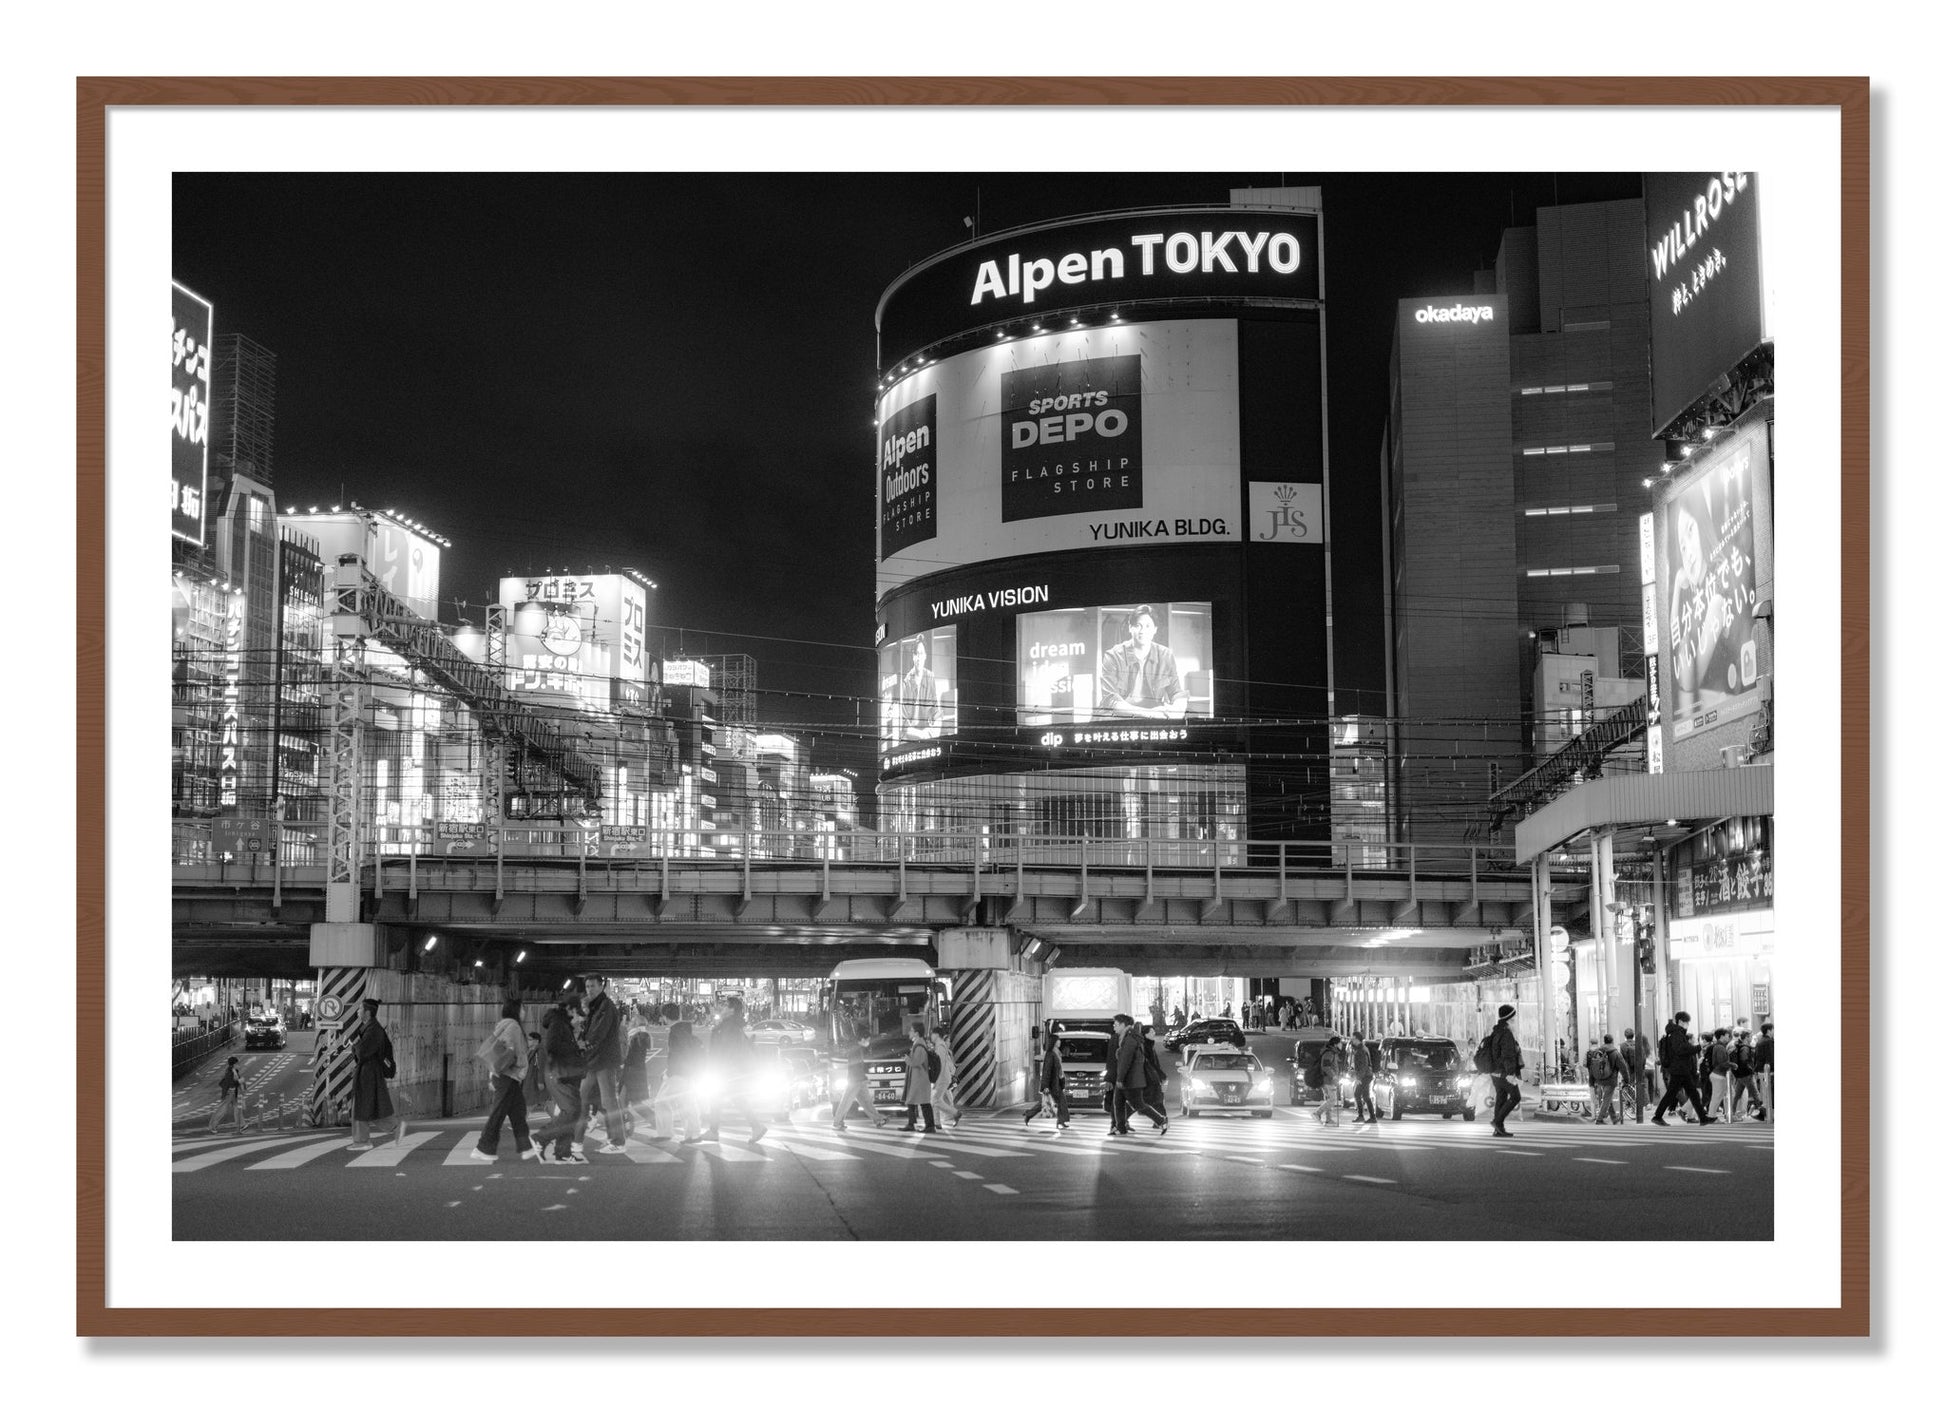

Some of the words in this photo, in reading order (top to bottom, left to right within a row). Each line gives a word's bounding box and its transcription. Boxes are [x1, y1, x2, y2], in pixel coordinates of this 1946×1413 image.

[970, 245, 1124, 305] Alpen
[1131, 231, 1300, 275] TOKYO
[1414, 304, 1494, 324] okadaya
[1028, 390, 1109, 415] SPORTS
[1011, 409, 1128, 449] DEPO
[883, 425, 929, 471] Alpen
[1011, 457, 1129, 482] FLAGSHIP
[886, 462, 929, 503] Outdoors
[1054, 475, 1129, 493] STORE
[883, 491, 930, 525] FLAGSHIP
[896, 508, 930, 531] STORE
[1089, 519, 1170, 541] YUNIKA
[1174, 518, 1231, 537] BLDG.
[289, 585, 319, 606] SHISHA
[525, 580, 595, 600] プロミス
[931, 593, 985, 619] YUNIKA
[988, 585, 1049, 610] VISION
[1029, 641, 1086, 659] dream
[1040, 732, 1064, 747] dip
